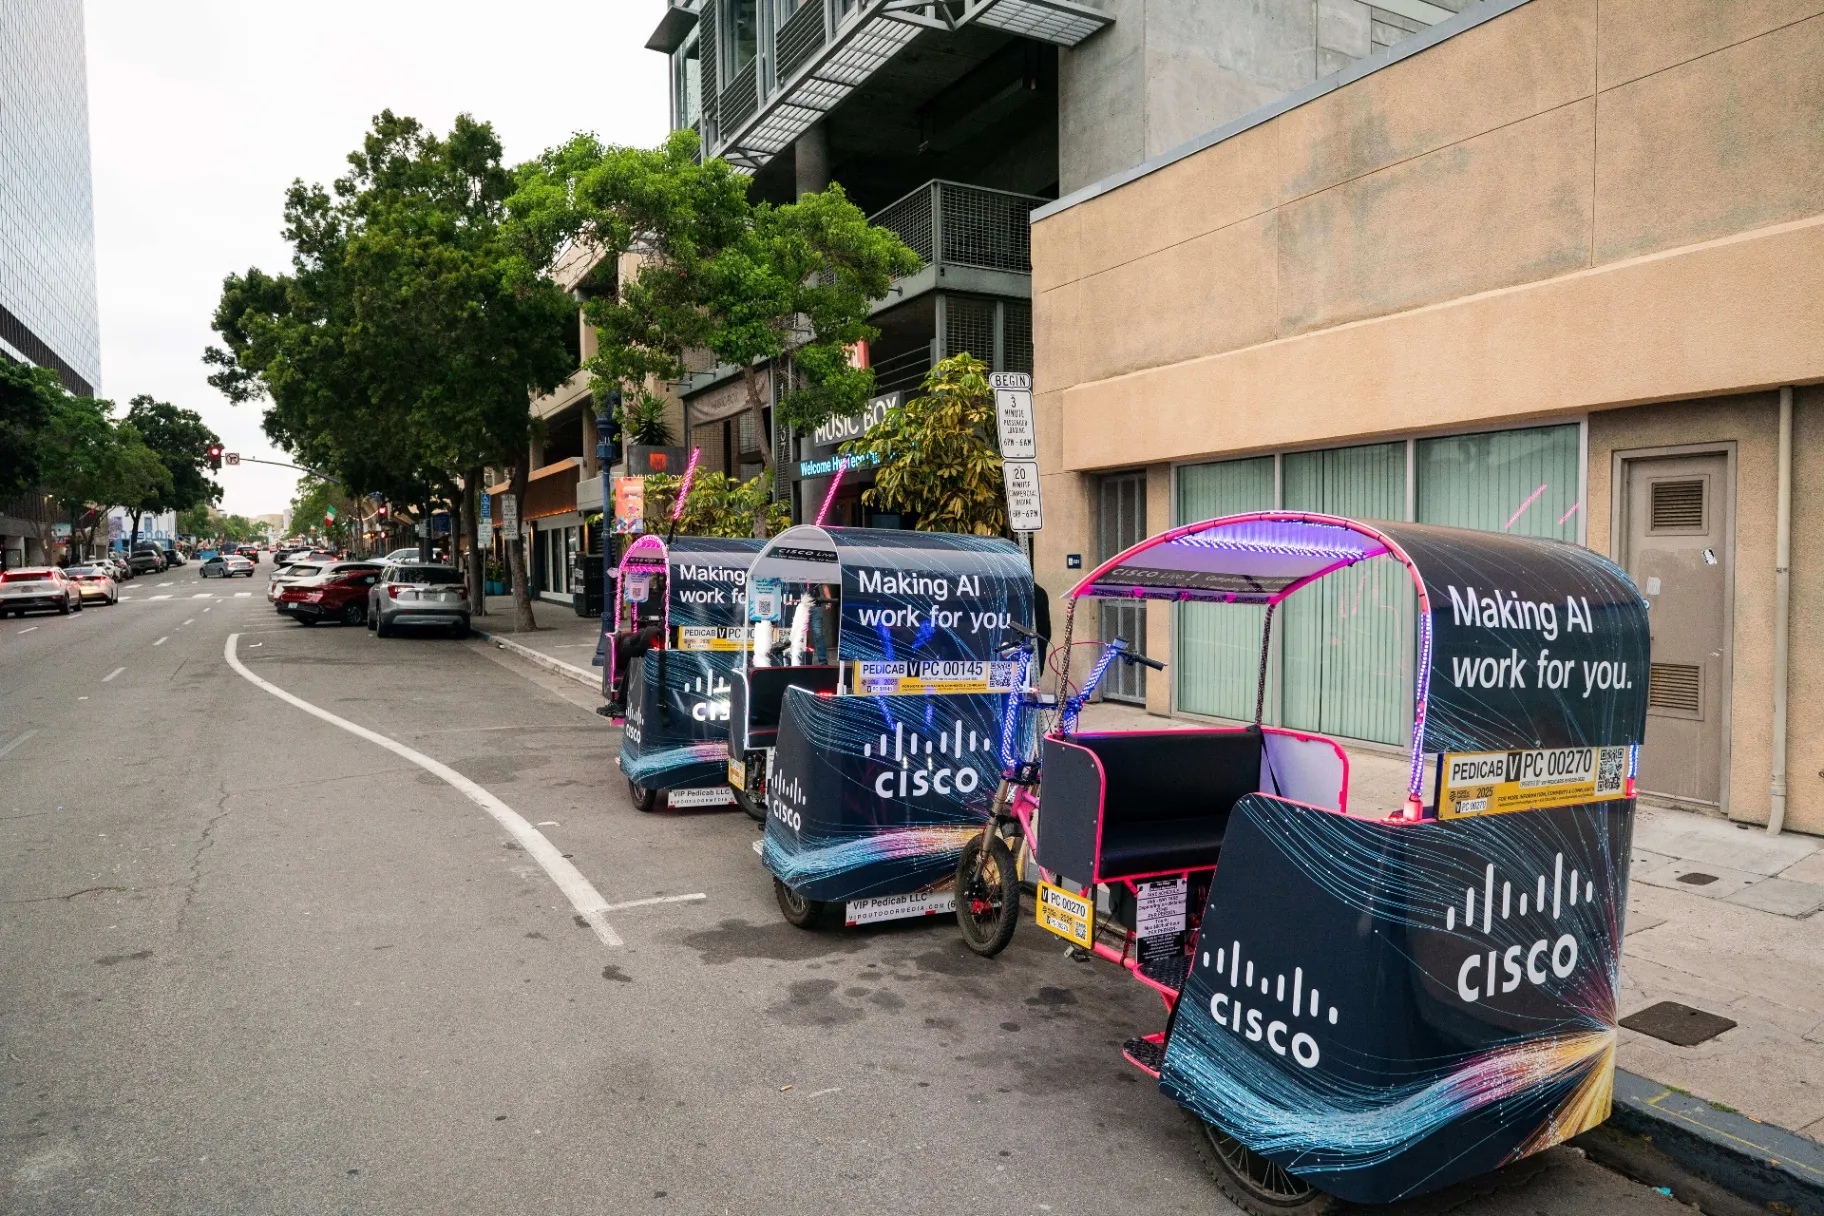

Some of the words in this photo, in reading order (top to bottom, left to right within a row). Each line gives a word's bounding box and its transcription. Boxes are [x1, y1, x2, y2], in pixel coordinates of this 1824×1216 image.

[995, 375, 1026, 386] BEGIN
[1011, 396, 1016, 408] 3
[1004, 409, 1024, 418] MINUTE
[815, 409, 859, 443] MUSIC
[800, 460, 832, 476] Welcome
[1013, 468, 1026, 479] 20
[679, 564, 746, 585] Making
[1111, 568, 1158, 578] CISCO
[679, 588, 725, 603] work
[731, 588, 747, 604] fo
[858, 570, 948, 601] Making
[956, 574, 980, 597] AI
[858, 605, 920, 627] work
[929, 605, 963, 628] for
[1447, 585, 1558, 641] Making
[1566, 595, 1593, 634] AI
[684, 628, 716, 637] PEDICAB
[728, 628, 740, 638] PC
[863, 664, 905, 675] PEDICAB
[922, 661, 939, 675] PC
[943, 661, 983, 675] 00145
[1452, 648, 1527, 689] work
[1537, 649, 1575, 689] for
[1582, 660, 1632, 698] you.
[692, 700, 730, 721] CIS
[626, 723, 641, 744] CISCO
[1452, 759, 1504, 781] PEDICAB
[1523, 754, 1544, 779] PC
[1547, 748, 1593, 776] 00270
[687, 789, 714, 797] Pedicab
[875, 767, 978, 798] CISCO
[1477, 786, 1494, 798] 2025
[773, 800, 801, 831] CISCO
[1461, 802, 1470, 811] PC
[853, 900, 868, 910] VIP
[871, 895, 907, 908] Pedicab
[909, 892, 927, 903] LLC
[1051, 892, 1060, 906] PC
[1062, 898, 1085, 917] 00270
[1457, 933, 1578, 1002] CISCO
[1210, 992, 1320, 1068] CISCO
